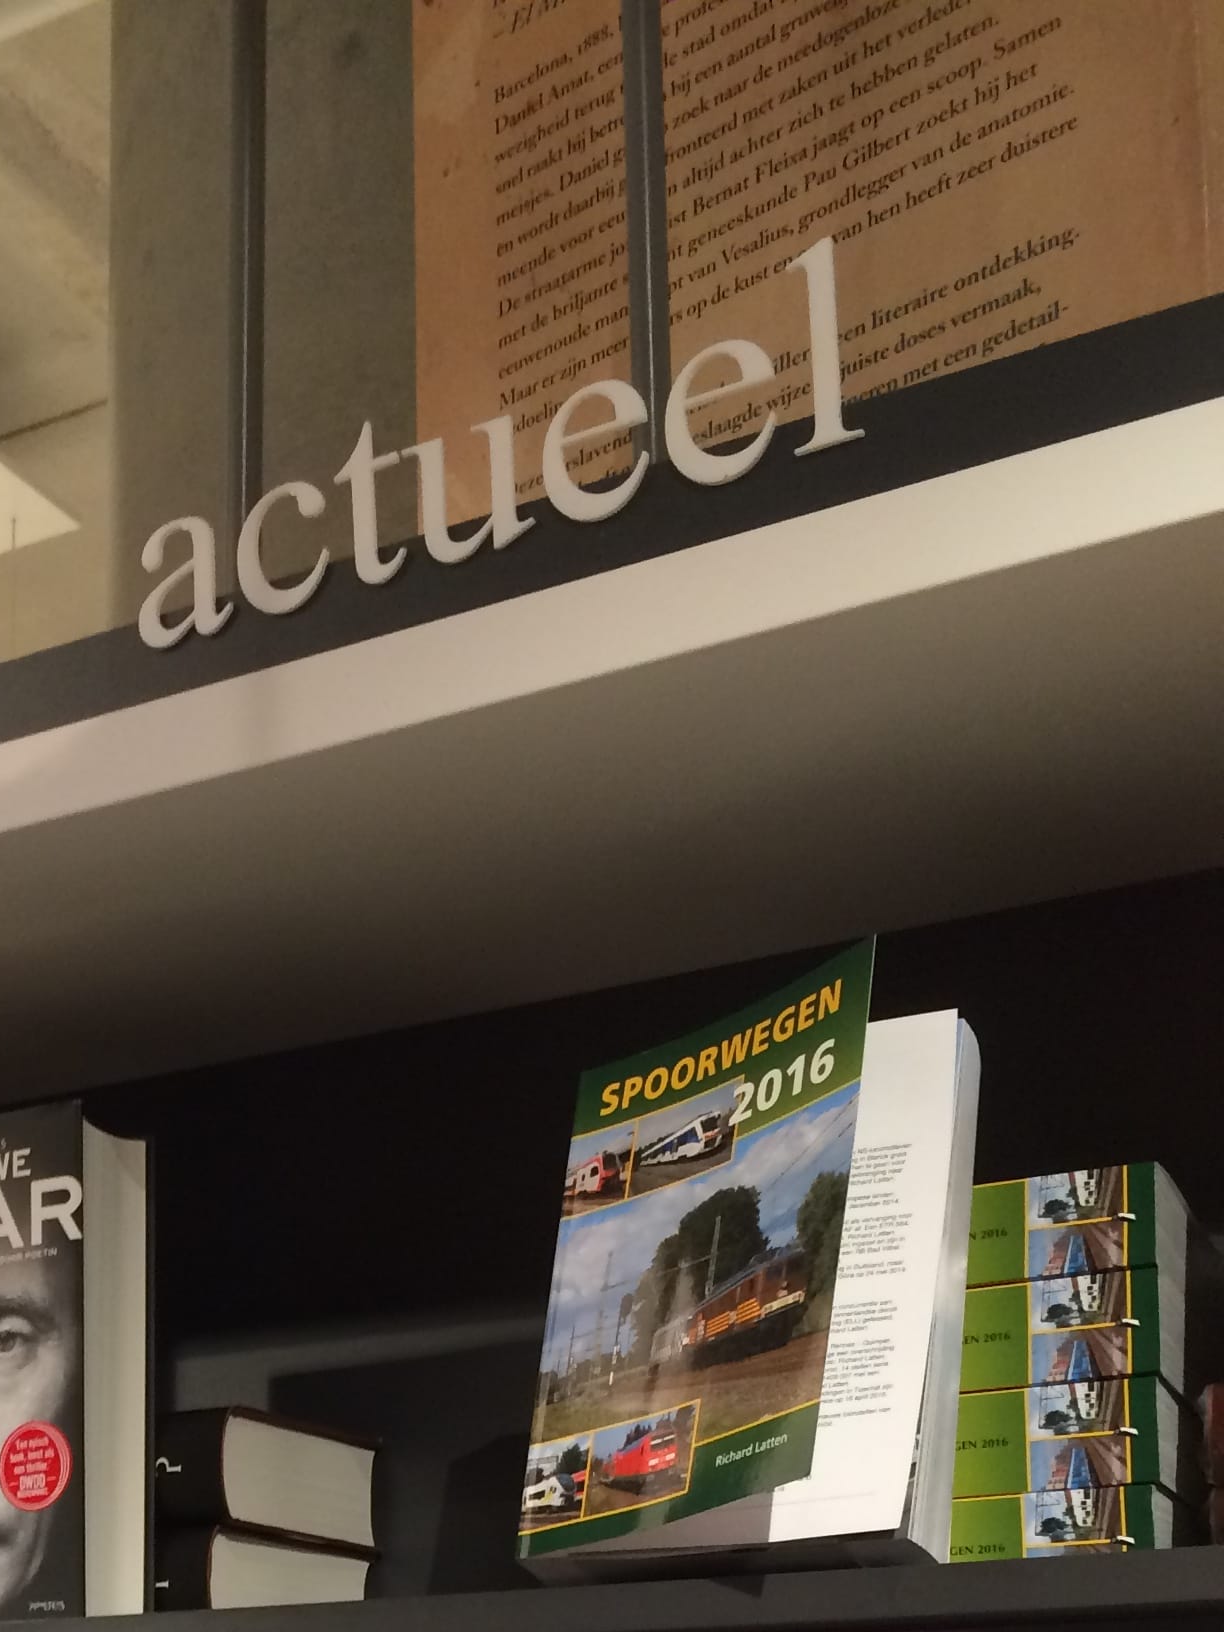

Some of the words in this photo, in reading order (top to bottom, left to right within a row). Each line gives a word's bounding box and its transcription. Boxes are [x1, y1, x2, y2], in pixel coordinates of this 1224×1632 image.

[493, 108, 570, 164] wezigheid
[574, 88, 616, 120] terug
[695, 61, 723, 85] een
[727, 24, 776, 67] aantal
[494, 53, 574, 105] Barcelona,
[578, 25, 614, 57] 1888,
[494, 92, 546, 136] Daniel
[548, 71, 594, 101] Amat,
[682, 25, 716, 57] stad
[559, 149, 610, 192] Daniel
[741, 97, 775, 126] met
[778, 69, 828, 106] zaken
[832, 50, 858, 77] uit
[863, 34, 893, 61] het
[497, 245, 558, 289] meende
[559, 225, 595, 254] voor
[691, 174, 751, 218] Bernat
[753, 146, 809, 185] Fleixa
[810, 120, 857, 162] jaagt
[860, 105, 885, 132] op
[888, 88, 922, 115] een
[992, 16, 1064, 61] Samen
[517, 211, 560, 246] wordt
[563, 178, 615, 222] daarbij
[682, 149, 726, 190] altijd
[729, 125, 784, 166] achter
[787, 102, 824, 136] zich
[829, 93, 846, 112] te
[850, 54, 919, 101] hebben
[923, 14, 1001, 69] gelaten.
[527, 147, 563, 179] raakt
[567, 131, 586, 155] hij
[673, 94, 711, 131] zoek
[713, 77, 750, 107] naar
[752, 64, 774, 85] de
[498, 296, 522, 320] De
[525, 252, 607, 303] straatarme
[687, 183, 798, 258] geneeskunde
[802, 164, 838, 194] Pau
[841, 126, 913, 172] Gilbert
[916, 96, 970, 136] zoekt
[974, 77, 1000, 106] hij
[1005, 61, 1039, 91] het
[498, 323, 526, 350] met
[530, 311, 550, 333] de
[553, 276, 618, 321] briljante
[687, 261, 717, 284] van
[720, 222, 795, 266] Vesalius,
[797, 158, 909, 235] grondlegger
[911, 145, 945, 172] van
[949, 129, 973, 154] de
[976, 81, 1075, 141] anatomie.
[498, 322, 591, 380] eeuwenoude
[686, 297, 708, 320] op
[710, 284, 730, 305] de
[733, 265, 770, 295] kust
[830, 221, 863, 245] van
[867, 201, 901, 229] hen
[905, 171, 953, 211] heeft
[956, 153, 998, 187] zeer
[999, 115, 1079, 165] duistere
[871, 284, 949, 331] literaire
[953, 226, 1081, 292] ontdekking.
[499, 377, 539, 411] Maar
[542, 371, 559, 390] er
[560, 356, 587, 382] zijn
[590, 334, 630, 366] meer
[839, 344, 890, 385] juiste
[893, 322, 947, 355] doses
[950, 276, 1043, 329] vermaak,
[903, 356, 939, 386] met
[943, 343, 978, 367] een
[981, 299, 1070, 358] gedetail-
[138, 236, 865, 650] actueel
[599, 978, 843, 1117] SPOORWEGEN
[728, 1037, 836, 1127] 2016
[981, 1227, 1008, 1240] 2016
[983, 1331, 1012, 1344] 2016
[715, 1442, 754, 1468] Richard
[755, 1432, 789, 1454] Latten
[981, 1437, 1009, 1450] 2016
[977, 1542, 1006, 1555] 2016
